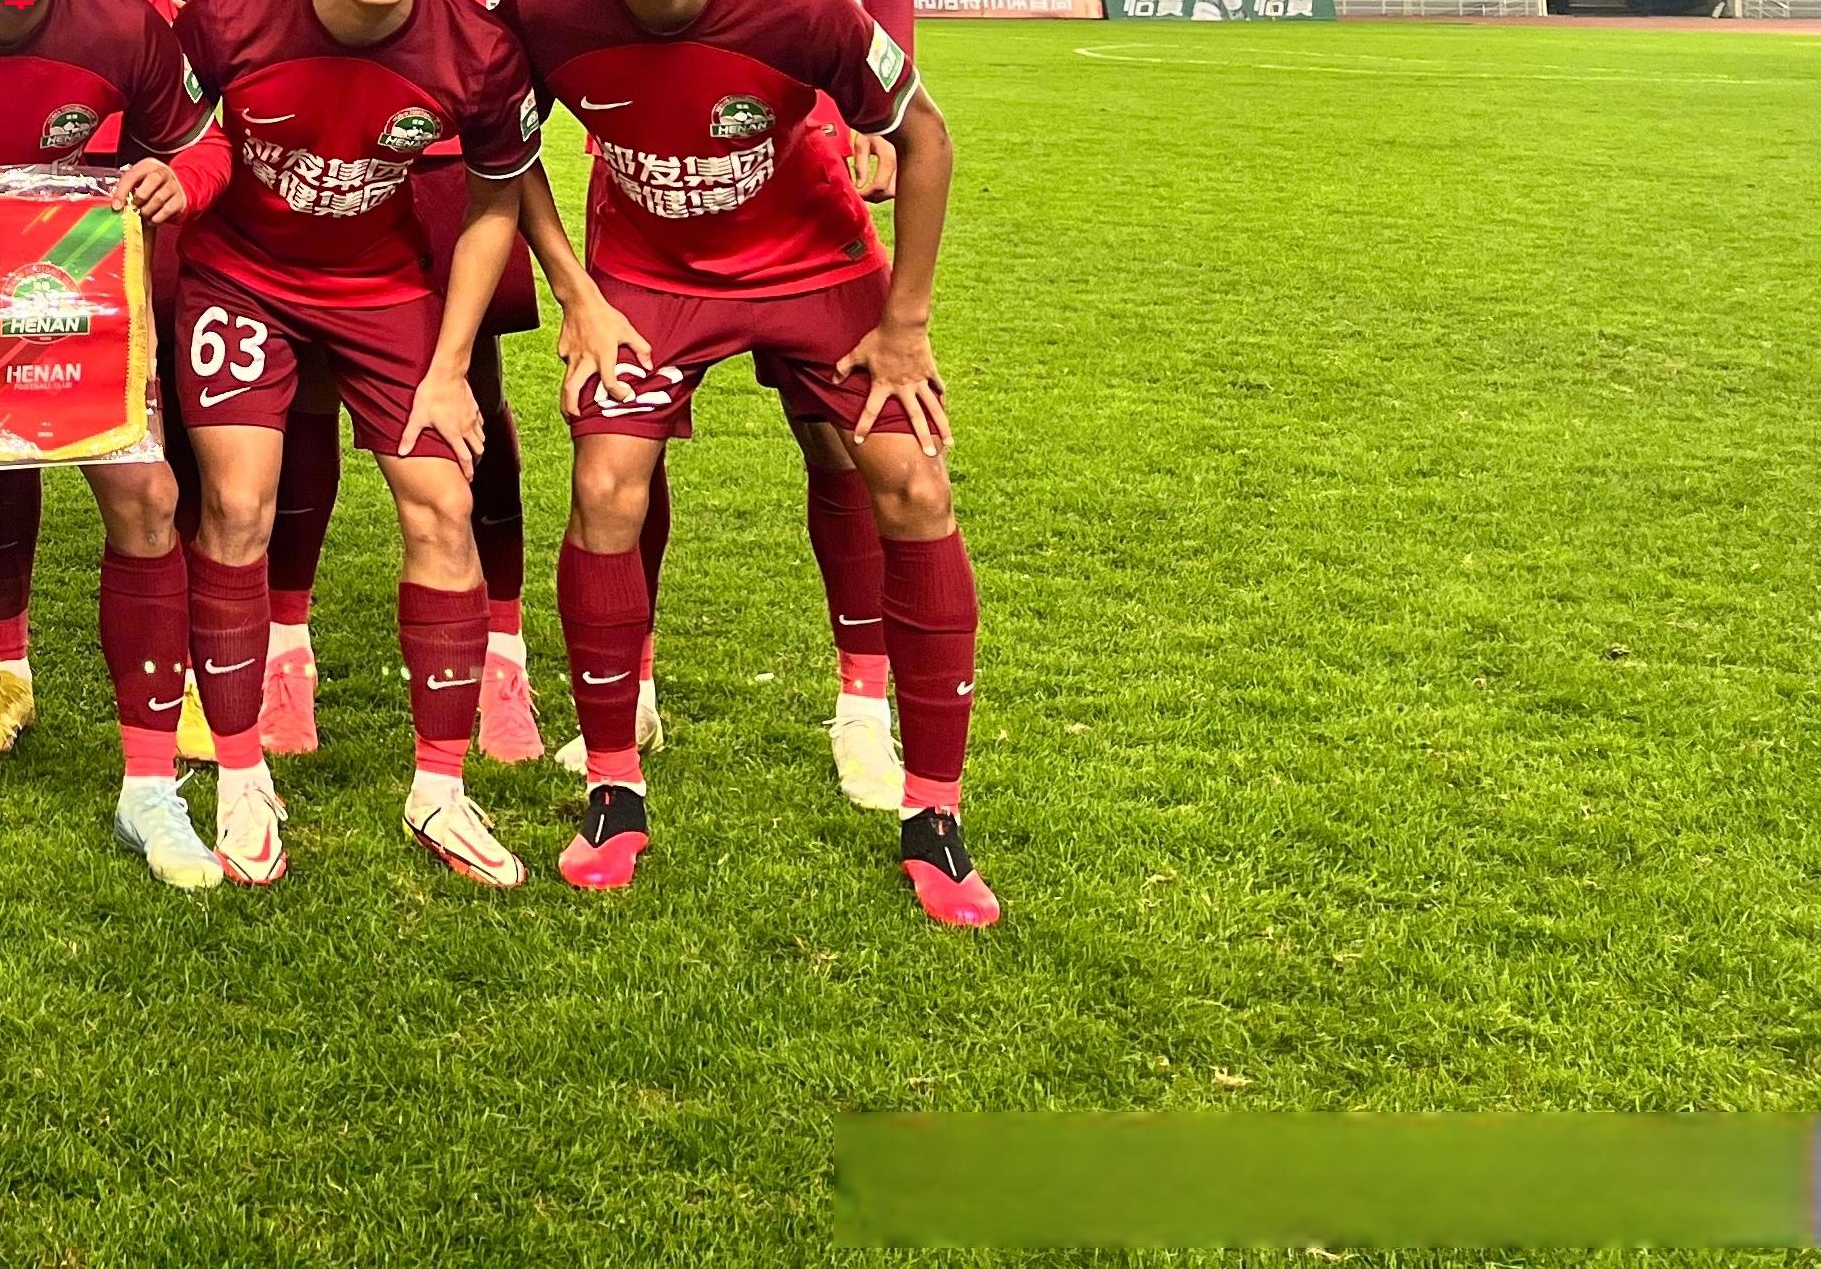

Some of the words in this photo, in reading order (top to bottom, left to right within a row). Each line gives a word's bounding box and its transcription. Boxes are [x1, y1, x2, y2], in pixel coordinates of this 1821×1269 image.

[718, 122, 767, 135] HENAN
[10, 317, 80, 334] HENAN
[191, 306, 268, 382] 63
[6, 362, 82, 383] HENAN
